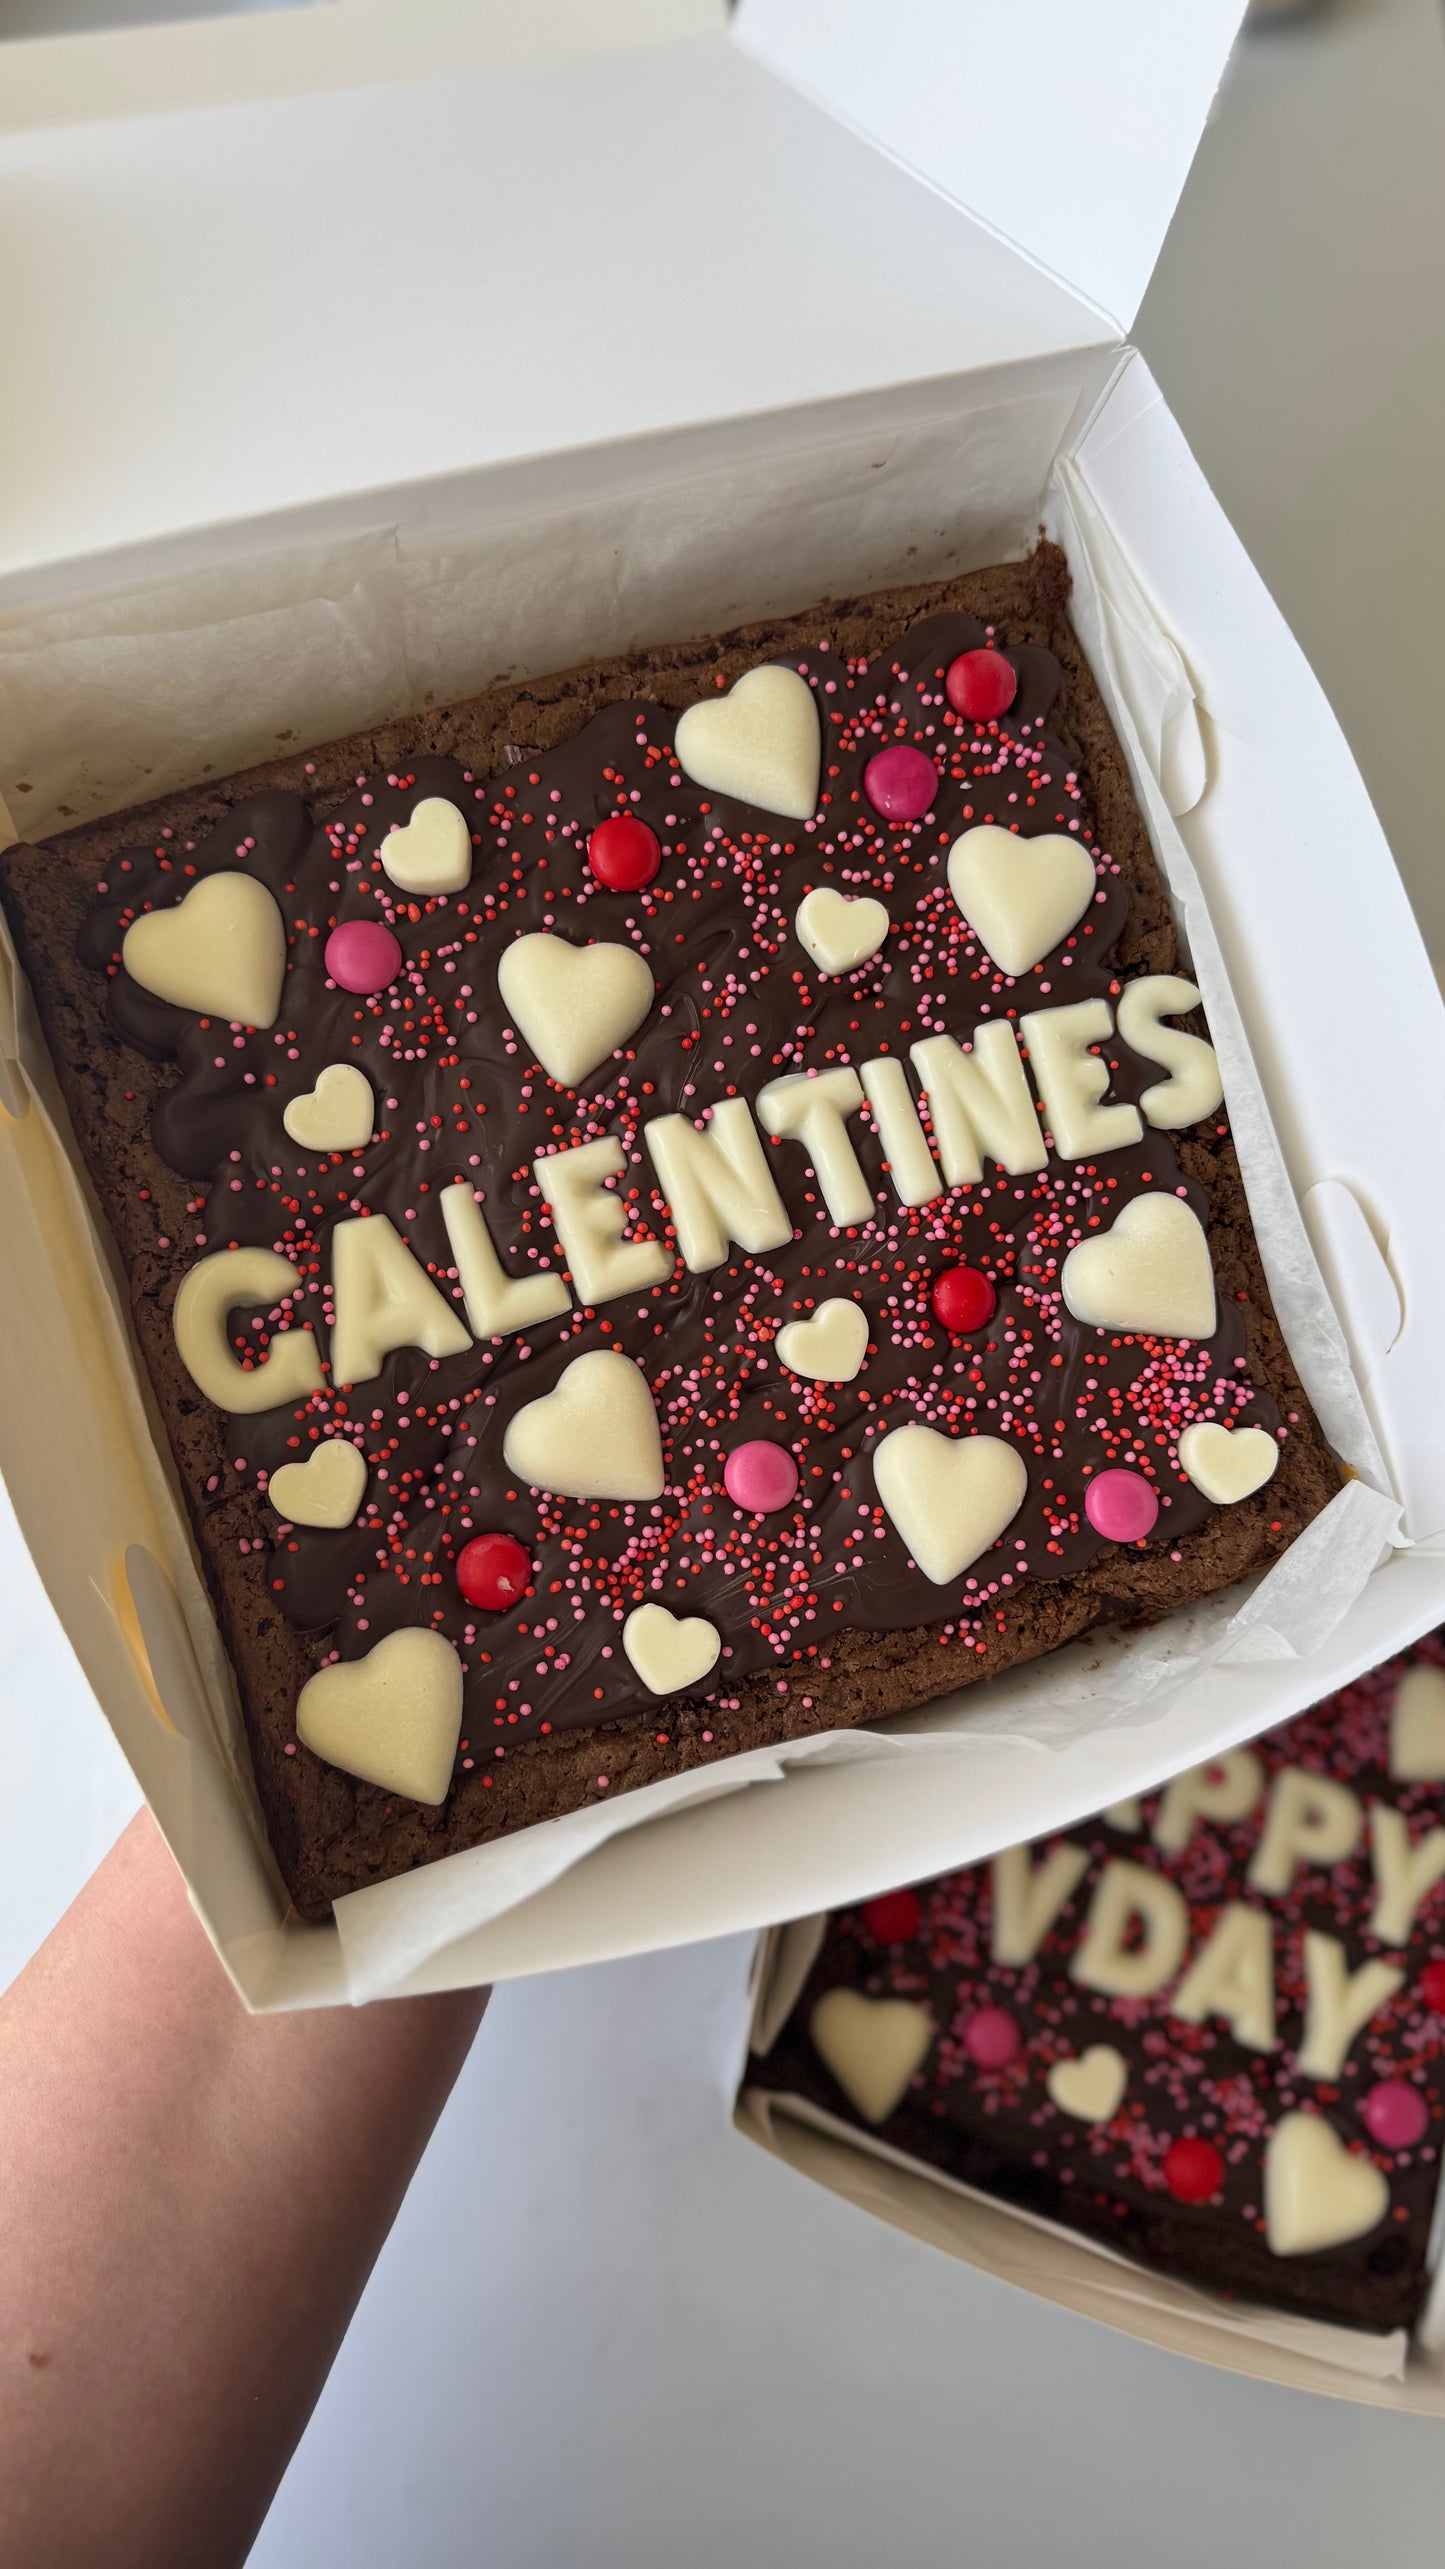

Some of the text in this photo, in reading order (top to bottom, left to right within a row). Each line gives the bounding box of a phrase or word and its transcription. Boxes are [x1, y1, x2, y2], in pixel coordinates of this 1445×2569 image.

[174, 975, 1225, 1414] GALENTINES
[990, 1842, 1406, 2082] VDAY
[1102, 1747, 1445, 1947] PPY
